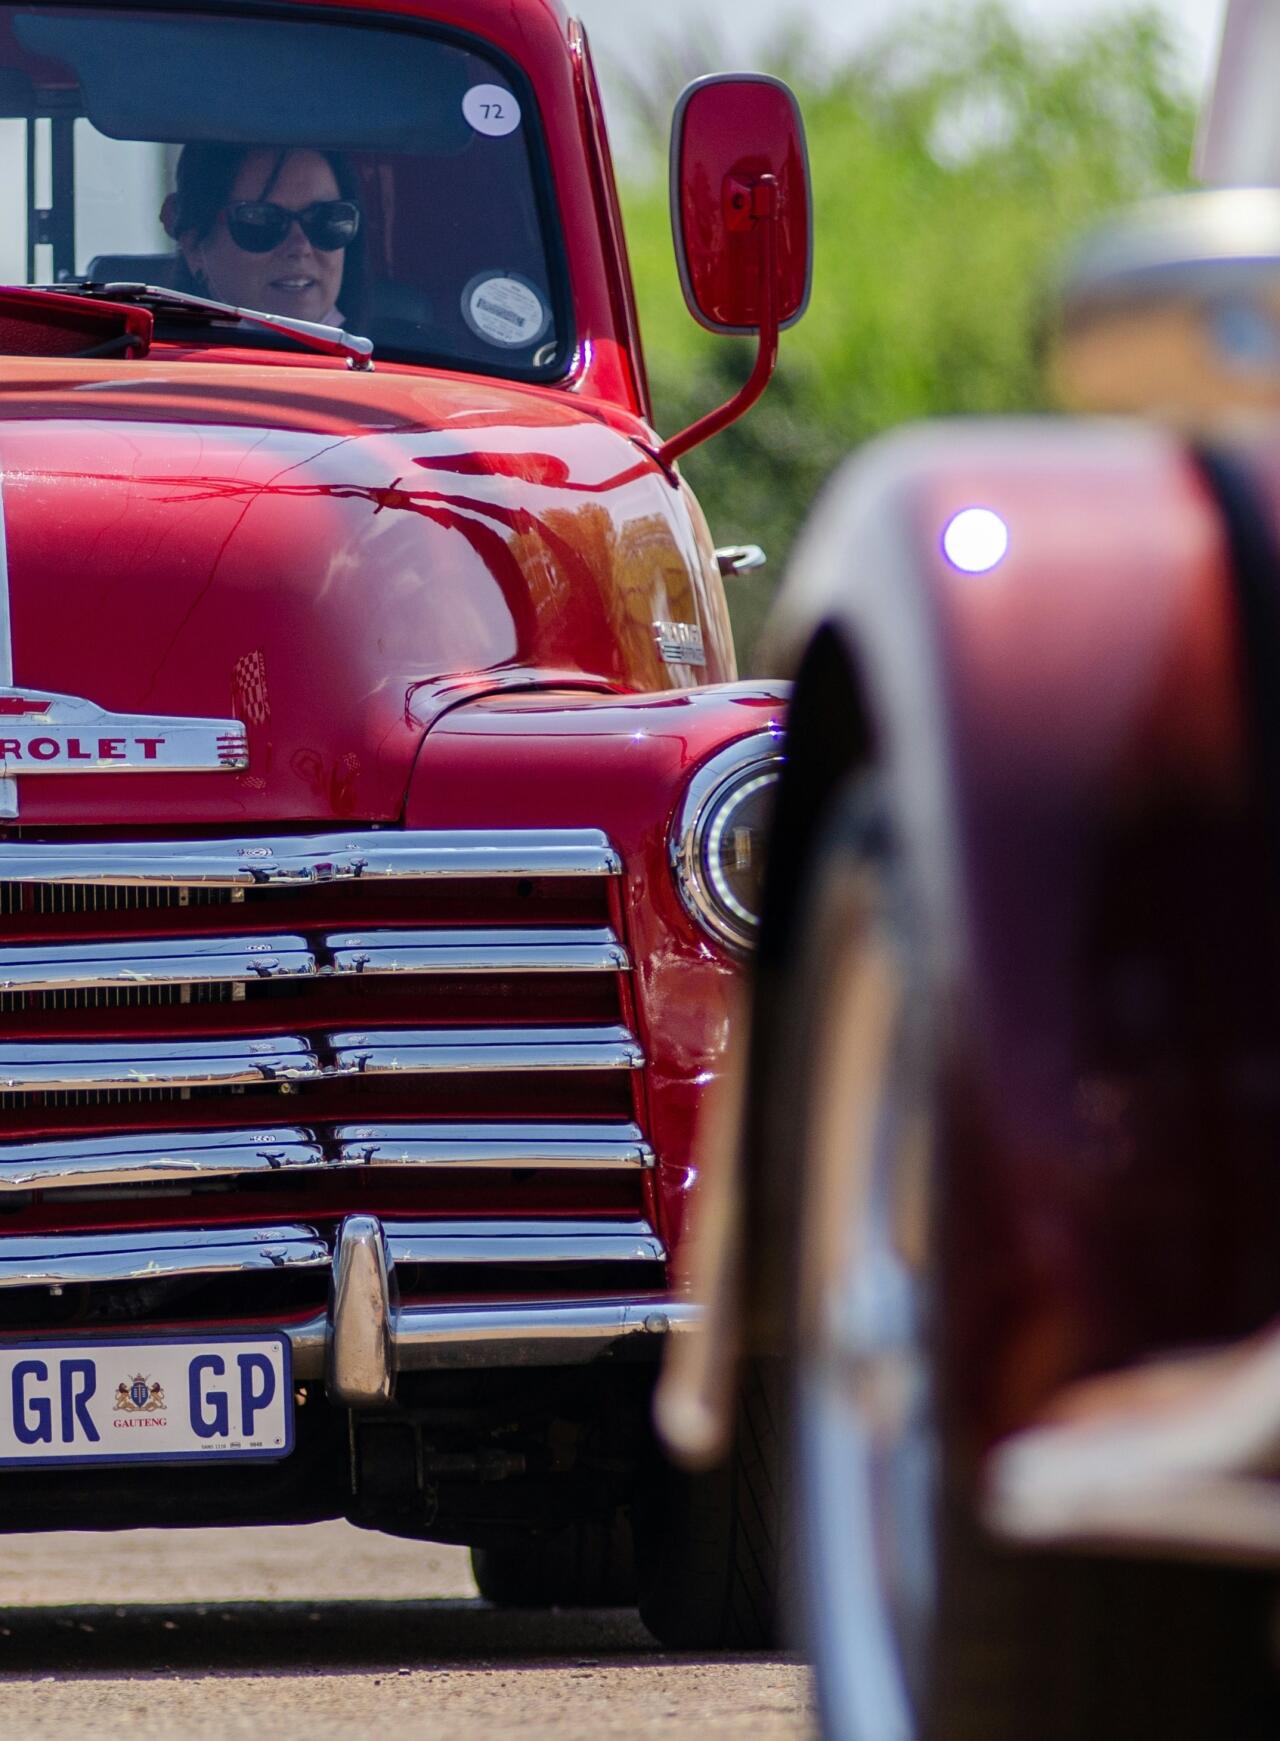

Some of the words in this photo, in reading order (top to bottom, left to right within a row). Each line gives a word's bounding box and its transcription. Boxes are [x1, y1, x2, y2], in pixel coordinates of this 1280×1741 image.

[479, 103, 505, 120] 72
[11, 1358, 101, 1445] GR
[188, 1353, 276, 1438] GP
[113, 1417, 167, 1429] GAUTENG
